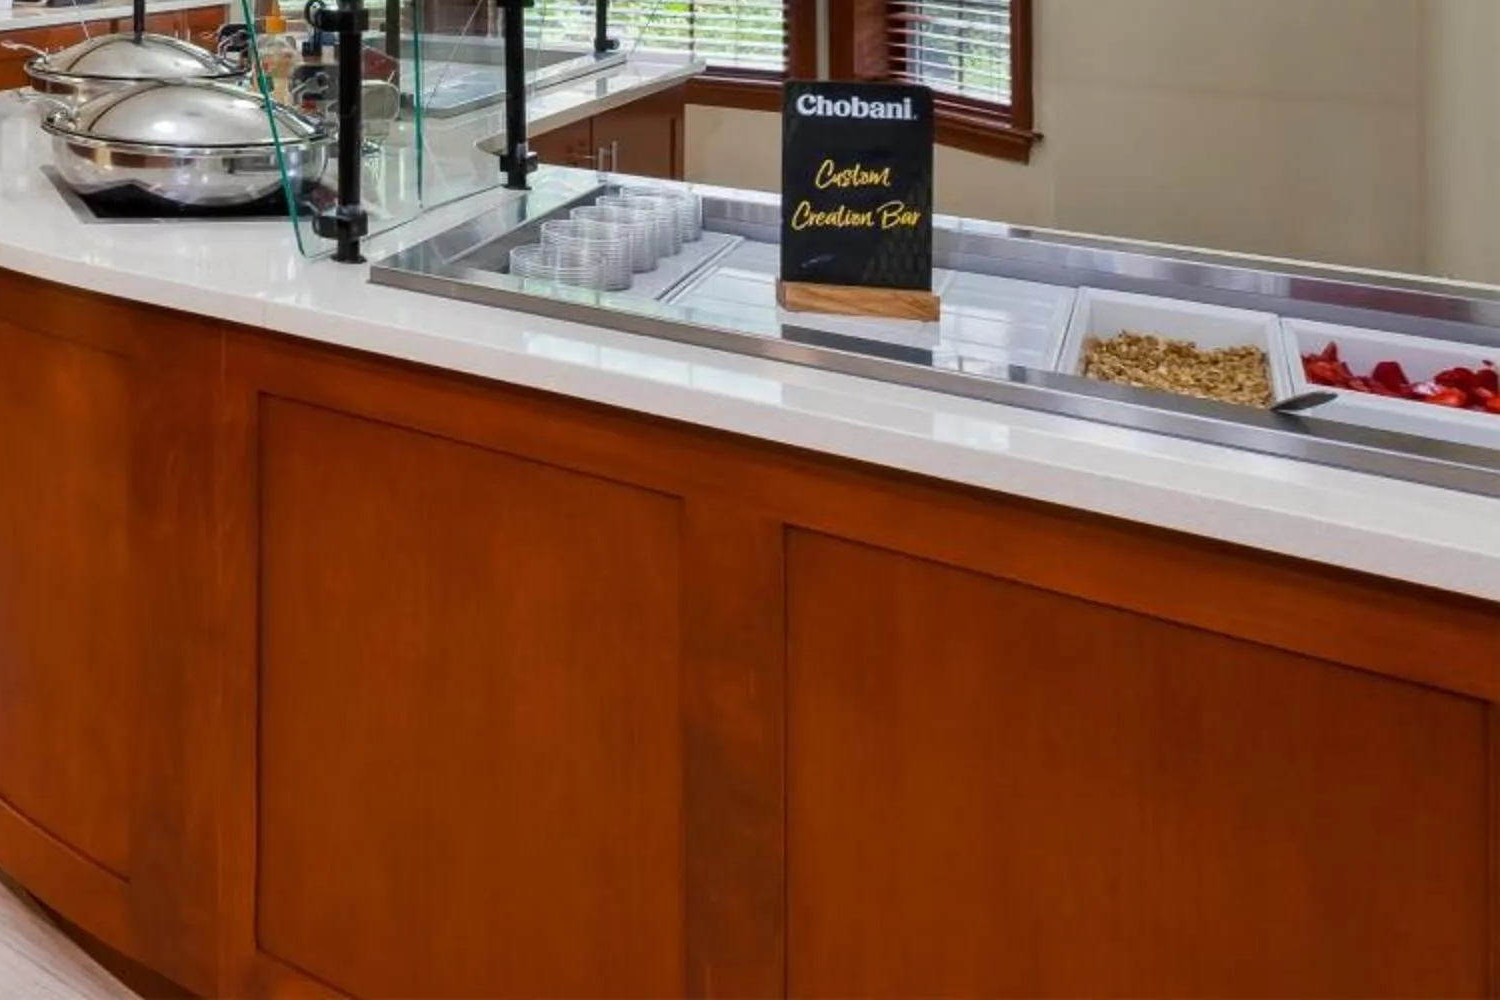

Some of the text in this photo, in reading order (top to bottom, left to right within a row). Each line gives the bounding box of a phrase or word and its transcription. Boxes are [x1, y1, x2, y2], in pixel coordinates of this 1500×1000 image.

[796, 93, 913, 120] Chobani
[815, 158, 892, 190] Custom
[791, 200, 922, 232] Creation Bar
